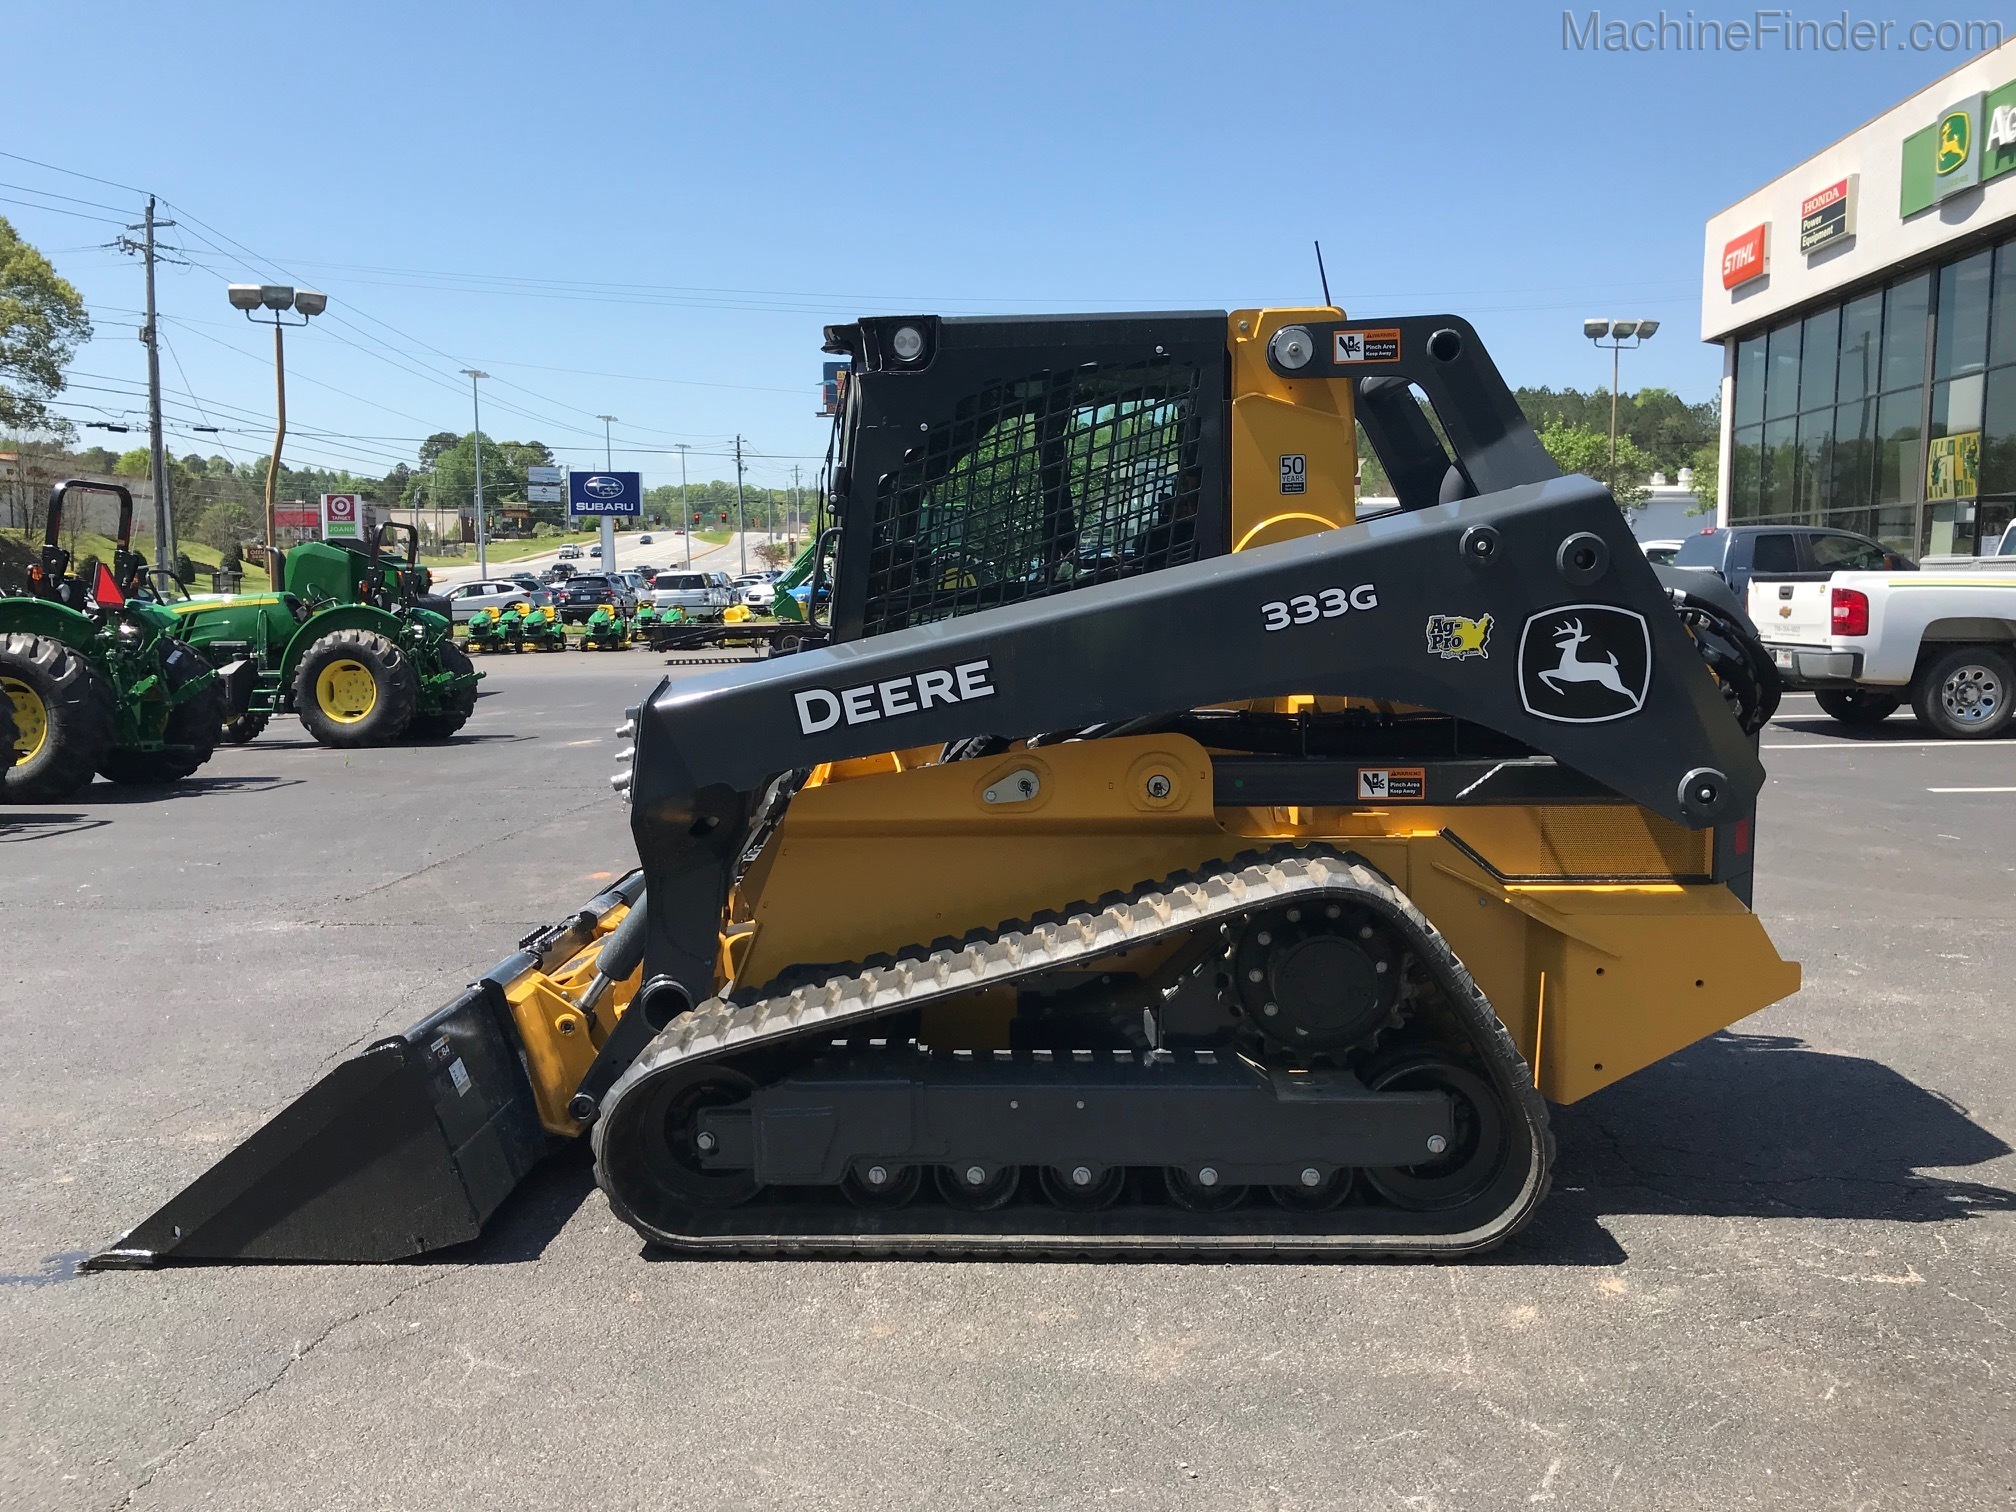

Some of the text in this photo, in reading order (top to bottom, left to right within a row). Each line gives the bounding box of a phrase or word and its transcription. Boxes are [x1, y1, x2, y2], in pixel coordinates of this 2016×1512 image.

[1804, 187, 1840, 213] HONDA
[1803, 214, 1823, 231] Power
[1802, 224, 1834, 247] Equipment
[1723, 242, 1755, 275] STIHL
[1281, 456, 1304, 475] 50
[575, 502, 634, 511] SUBARU
[1261, 584, 1378, 631] 333G
[1429, 618, 1462, 636] Ag-
[1431, 634, 1462, 650] Pro
[794, 659, 995, 735] DEERE
